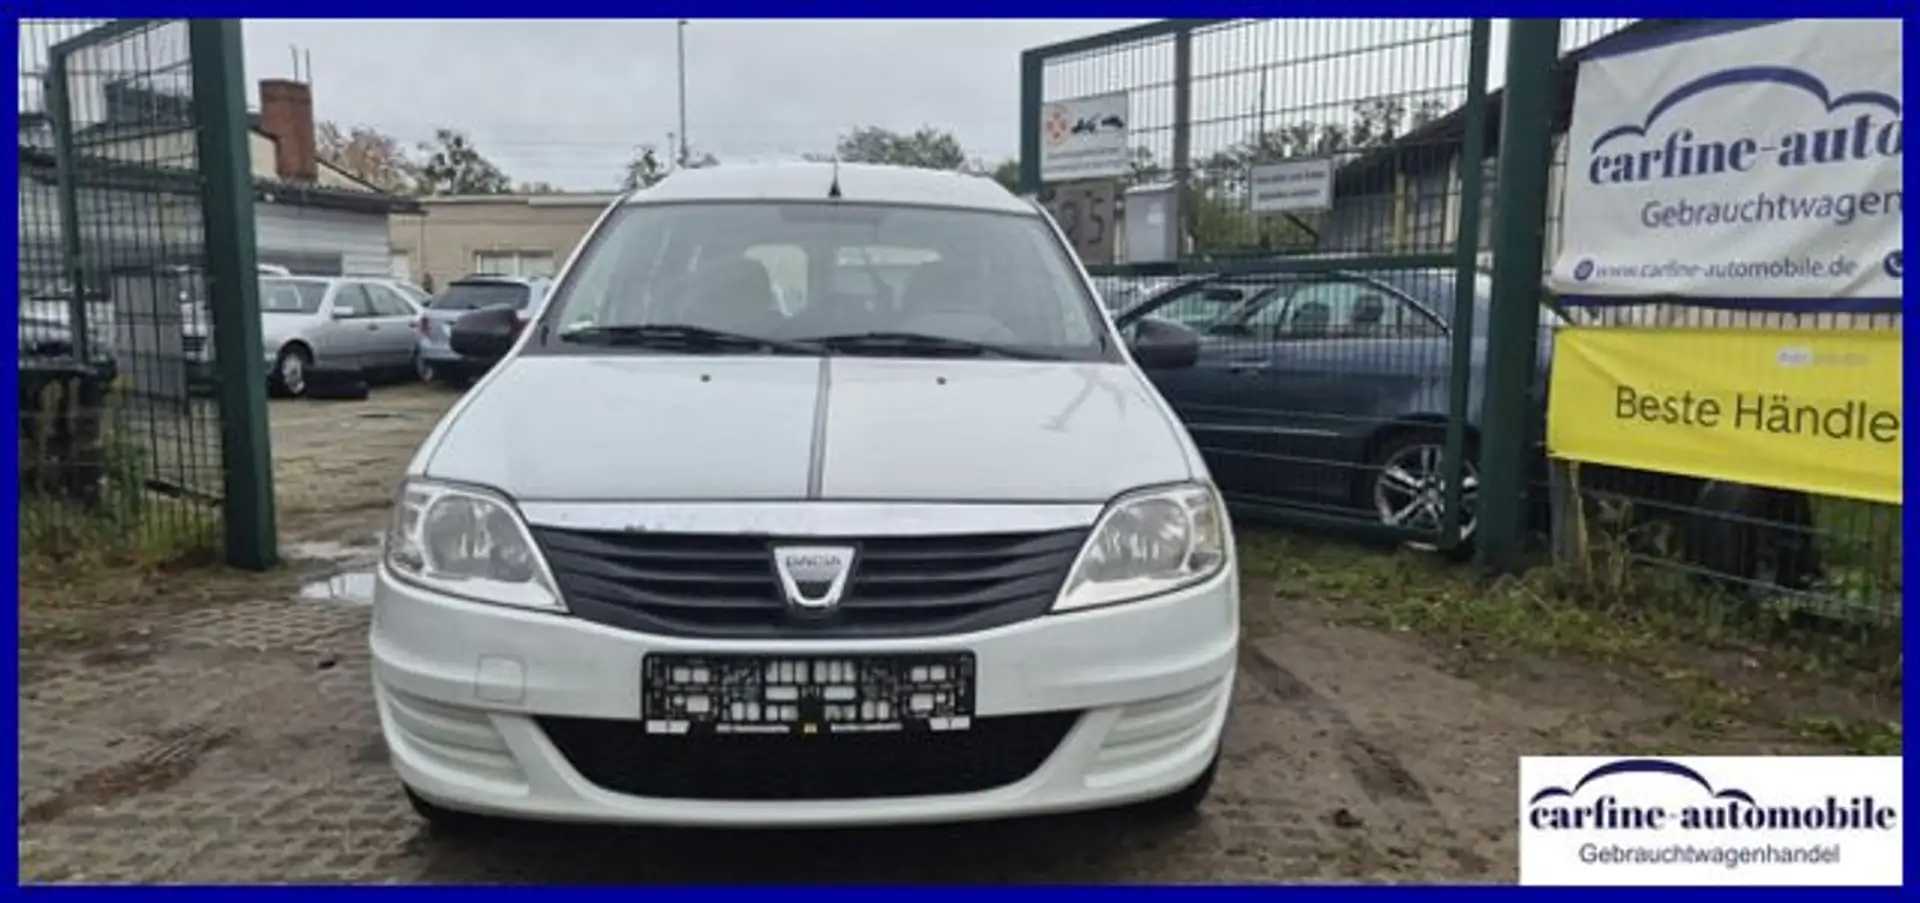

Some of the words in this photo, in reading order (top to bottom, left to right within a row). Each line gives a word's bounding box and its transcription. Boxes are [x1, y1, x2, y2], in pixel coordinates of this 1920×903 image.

[1588, 113, 1903, 185] carfine-auto
[1641, 188, 1903, 229] Gebrauchtwagen
[1595, 255, 1857, 279] www.carfine-automobile.de
[1615, 385, 1721, 428] Beste
[1733, 393, 1901, 443] Händle
